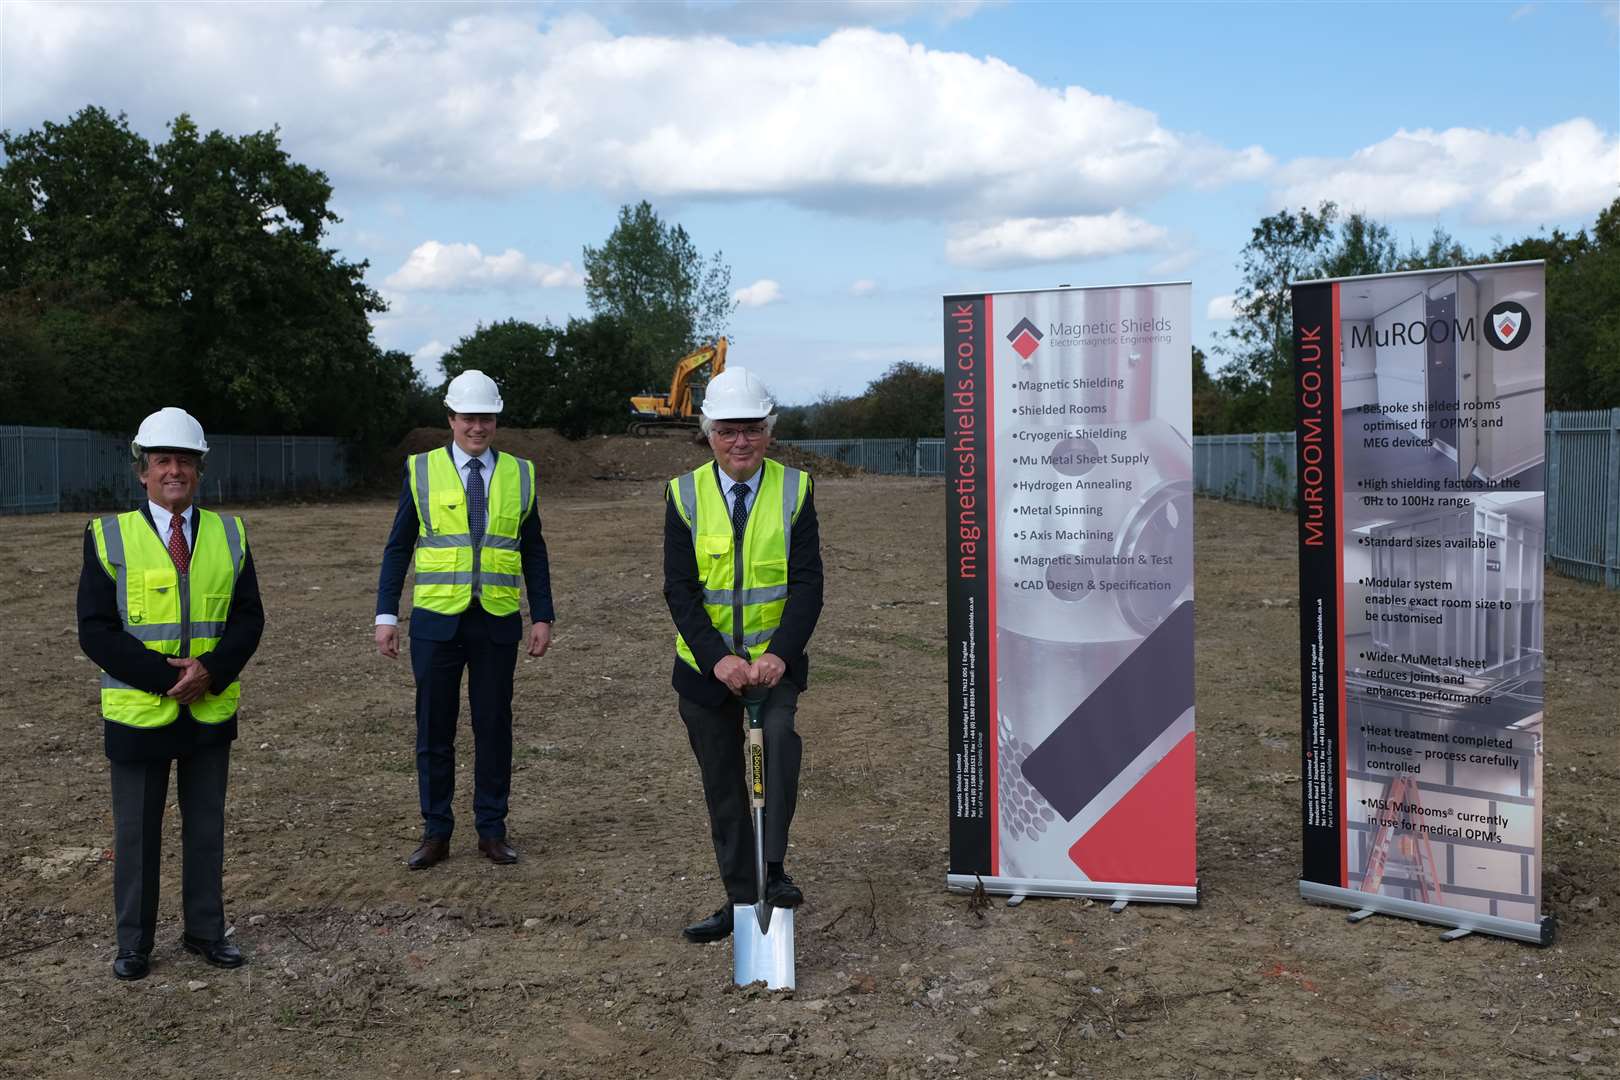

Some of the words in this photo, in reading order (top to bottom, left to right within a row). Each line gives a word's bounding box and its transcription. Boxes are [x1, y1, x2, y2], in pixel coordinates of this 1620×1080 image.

[1050, 322, 1116, 337] Magnetic
[1121, 318, 1172, 333] Shields
[1351, 317, 1475, 349] MuROOM
[1050, 338, 1117, 348] Electromagnetic
[1120, 334, 1172, 345] Engineering
[1019, 379, 1070, 392] Magnetic
[1073, 378, 1124, 389] Shielding
[1019, 405, 1065, 415] Shielded
[1070, 404, 1107, 414] Rooms
[1363, 402, 1408, 416] Bespoke
[1412, 400, 1459, 413] shielded
[1463, 400, 1500, 410] rooms
[1363, 418, 1417, 432] optimised
[1421, 418, 1436, 429] for
[1481, 416, 1503, 427] and
[951, 303, 980, 578] magneticshields.co.uk
[1019, 430, 1072, 442] Cryogenic
[1076, 428, 1127, 440] Shielding
[1301, 325, 1324, 547] MuROOM.CO.UK
[1364, 438, 1389, 448] MEG
[1392, 437, 1433, 447] devices
[1020, 456, 1037, 465] Mu
[1041, 454, 1073, 465] Metal
[1076, 454, 1108, 464] Sheet
[1111, 453, 1149, 465] Supply
[1020, 480, 1072, 492] Hydrogen
[1076, 479, 1132, 490] Annealing
[1364, 479, 1388, 492] High
[1391, 478, 1440, 491] shielding
[1444, 478, 1483, 489] factors
[1486, 477, 1497, 488] in
[1501, 477, 1520, 488] the
[1364, 496, 1384, 506] 0Hz
[1387, 496, 1398, 506] to
[1402, 495, 1434, 506] 100Hz
[1438, 497, 1470, 508] range
[1020, 505, 1052, 515] Metal
[1055, 505, 1103, 516] Spinning
[1020, 531, 1026, 540] 5
[1030, 530, 1052, 540] Axis
[1056, 530, 1114, 542] Machining
[1364, 536, 1412, 548] Standard
[1416, 537, 1441, 548] sizes
[1445, 537, 1496, 549] available
[1020, 555, 1072, 567] Magnetic
[1075, 554, 1134, 565] Simulation
[1138, 555, 1147, 565] &
[1151, 555, 1173, 565] Test
[1020, 580, 1043, 590] CAD
[1047, 580, 1083, 592] Design
[1087, 580, 1096, 590] &
[1099, 580, 1171, 592] Specification
[1365, 577, 1410, 589] Modular
[1414, 579, 1453, 592] system
[1365, 595, 1406, 606] enables
[1410, 597, 1438, 607] exact
[1441, 600, 1472, 609] room
[1475, 598, 1496, 609] size
[1500, 601, 1512, 610] to
[1365, 611, 1378, 621] be
[1381, 612, 1443, 624] customised
[1366, 651, 1397, 663] Wider
[1401, 653, 1452, 667] MuMetal
[1455, 656, 1487, 669] sheet
[1366, 668, 1407, 681] reduces
[1409, 672, 1440, 684] joints
[1443, 673, 1464, 685] and
[1366, 685, 1416, 698] enhances
[1419, 688, 1492, 705] performance
[1367, 725, 1392, 737] Heat
[1394, 727, 1449, 744] treatment
[1452, 733, 1513, 750] completed
[1367, 741, 1412, 756] in-house
[1425, 749, 1466, 762] process
[1469, 753, 1519, 769] carefully
[1367, 758, 1421, 774] controlled
[1368, 798, 1390, 810] MSL
[1457, 809, 1508, 828] currently
[1368, 814, 1378, 825] in
[1380, 817, 1398, 828] use
[1402, 819, 1416, 831] for
[1419, 822, 1462, 839] medical
